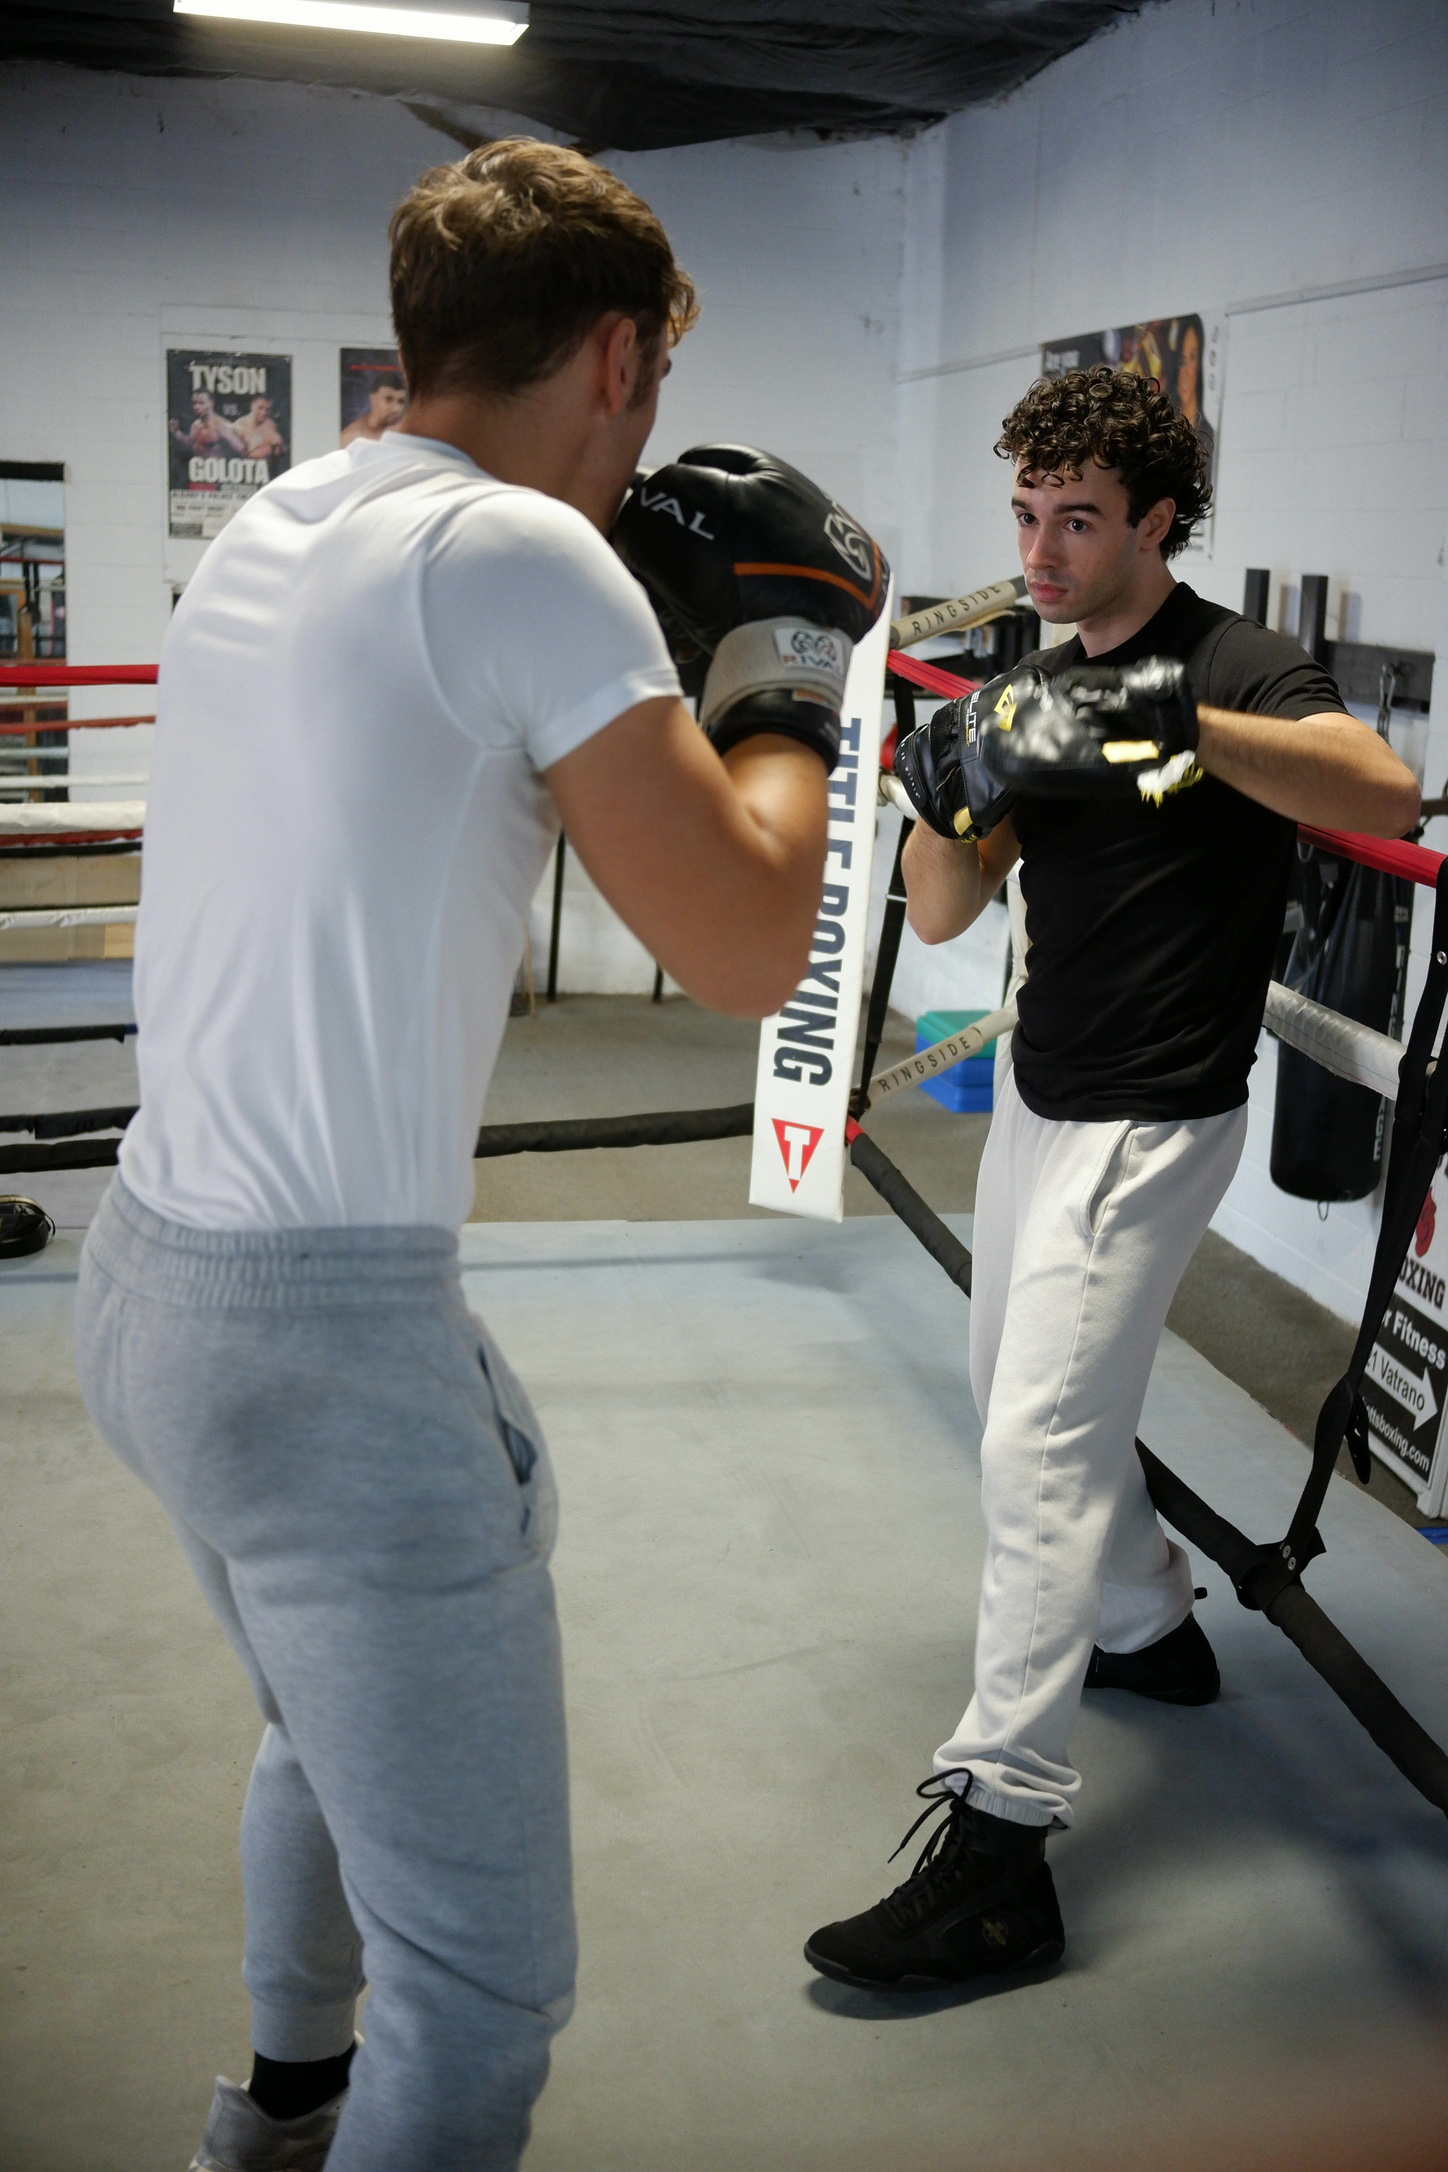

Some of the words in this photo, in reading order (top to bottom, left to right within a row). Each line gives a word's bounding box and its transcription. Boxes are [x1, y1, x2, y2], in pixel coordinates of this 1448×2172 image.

[189, 364, 267, 395] TYSON
[188, 456, 270, 485] GOLOTA
[640, 487, 716, 540] VAL
[911, 586, 1002, 636] RINGSIDE
[969, 690, 981, 742] ELITE
[877, 1037, 970, 1092] RINGSIDE
[1392, 1310, 1447, 1370] Fitness
[1381, 1356, 1425, 1411] Vatrano
